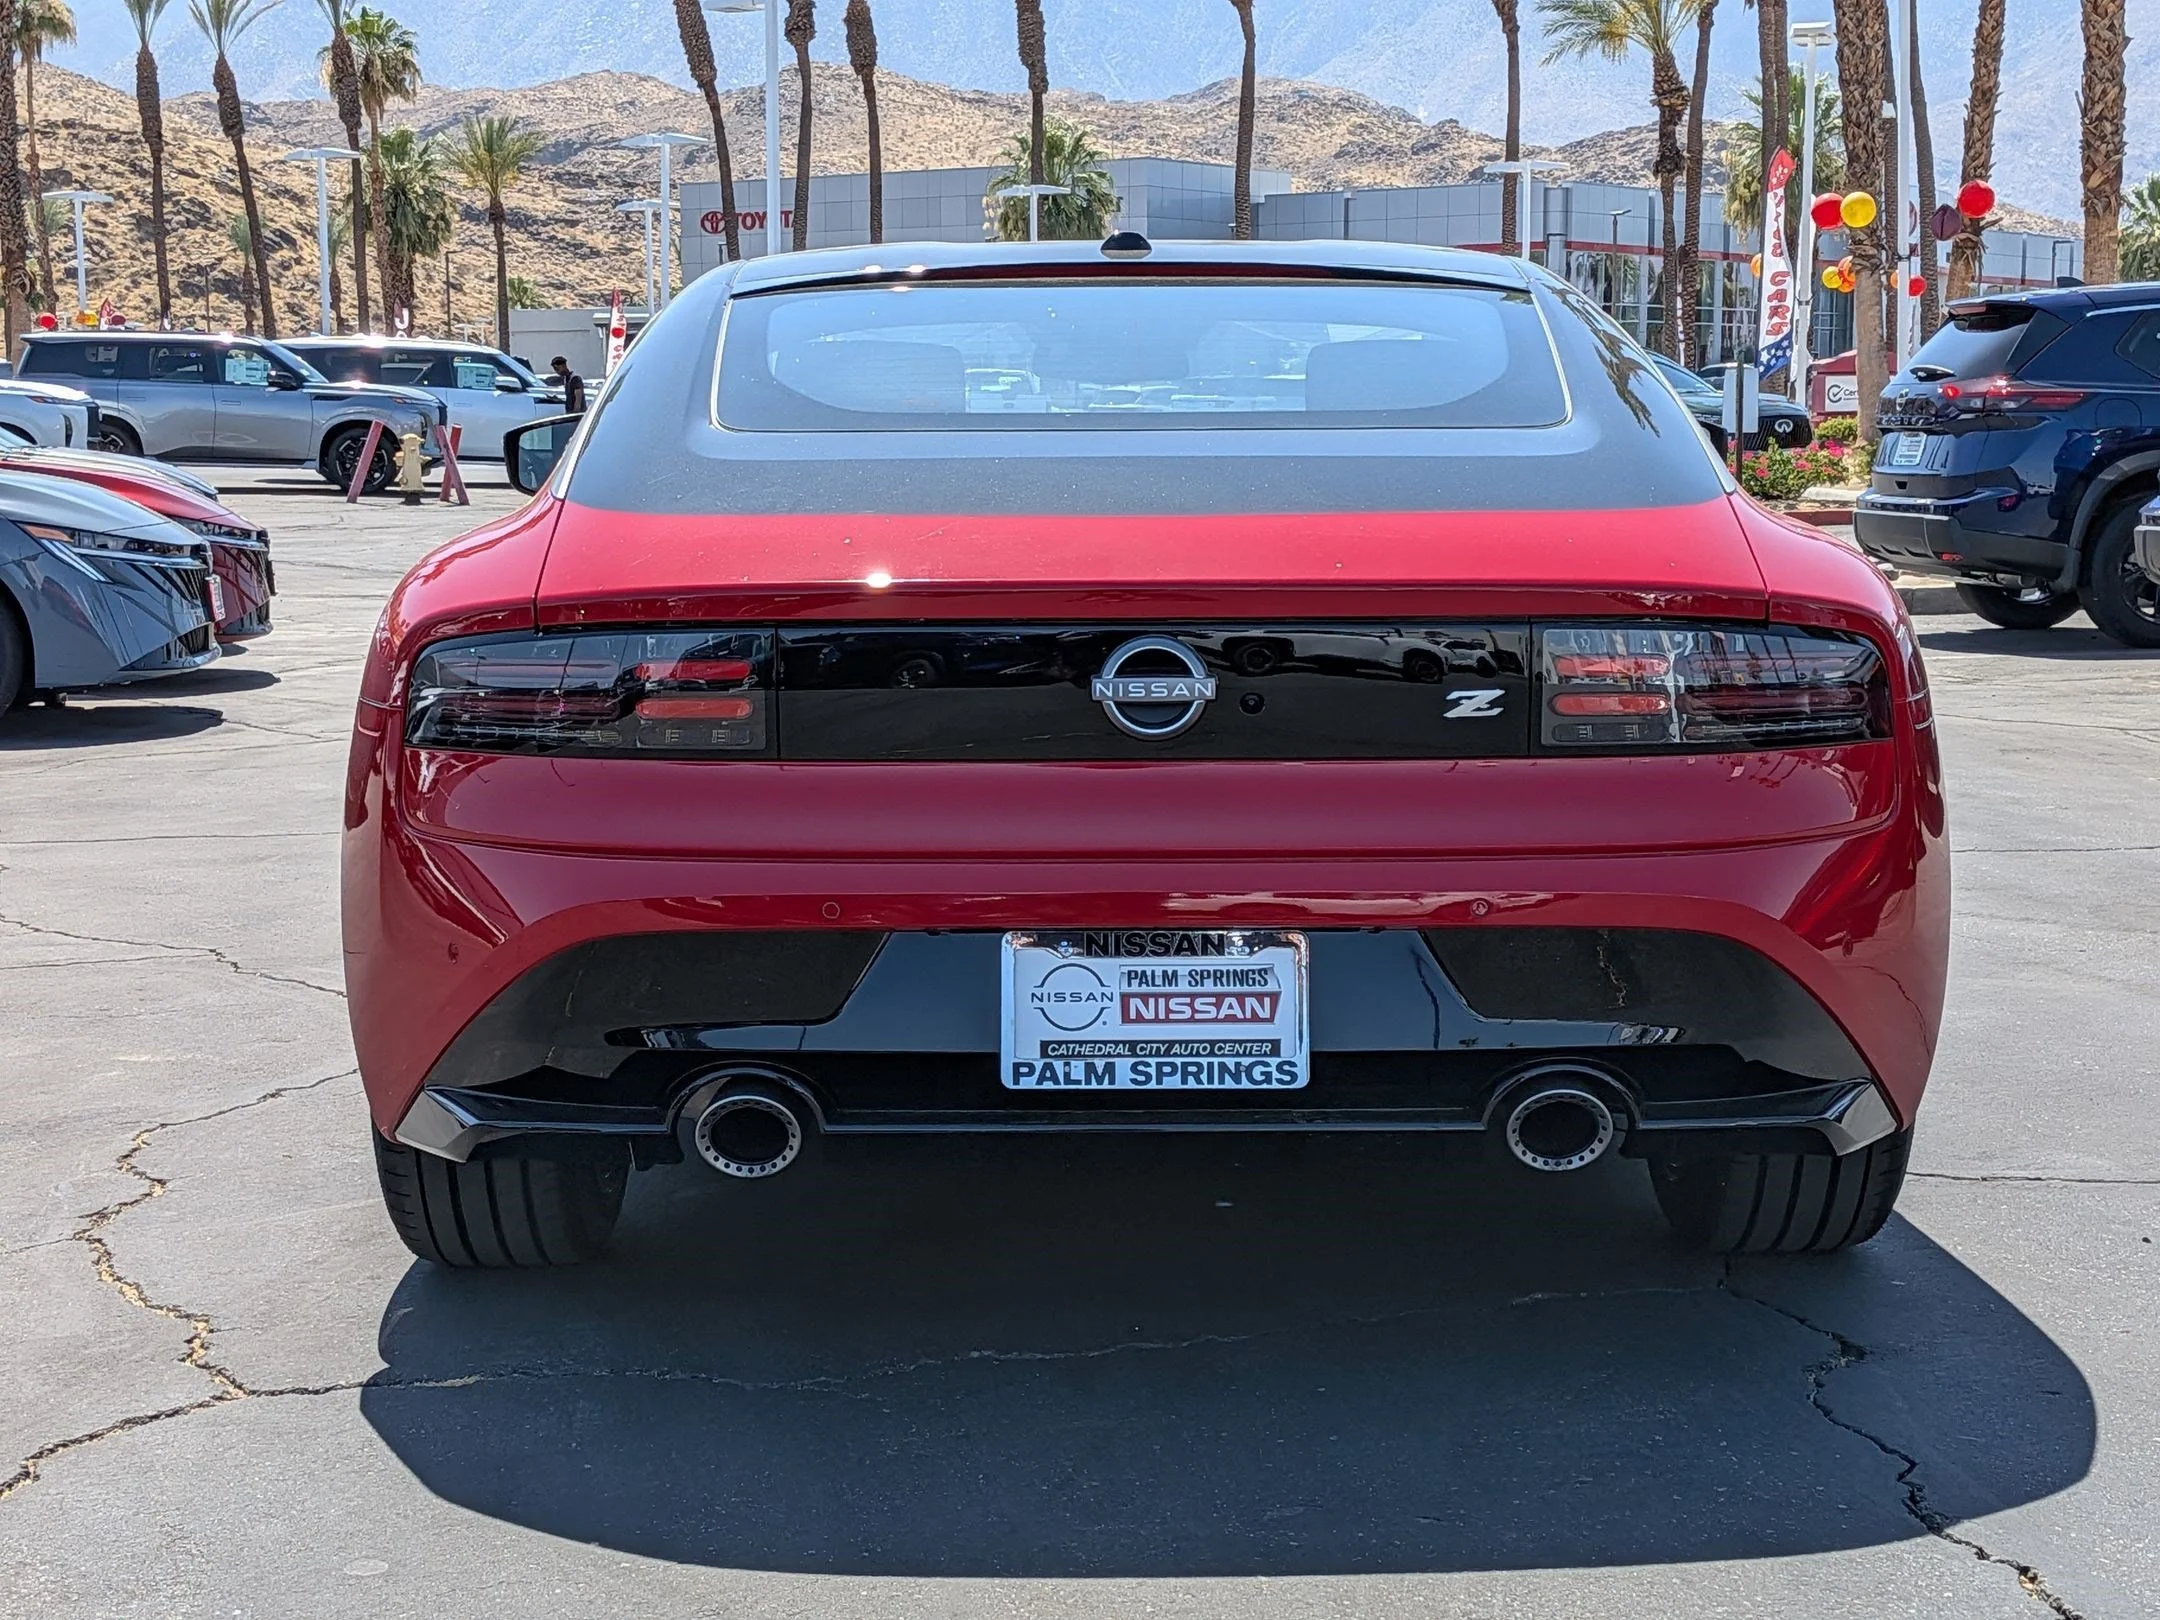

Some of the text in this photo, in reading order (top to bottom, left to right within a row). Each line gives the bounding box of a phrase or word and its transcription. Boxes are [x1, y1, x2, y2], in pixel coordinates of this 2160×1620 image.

[736, 210, 796, 231] OYT
[1766, 270, 1791, 336] CARS
[1095, 682, 1213, 698] NISSAN
[1442, 688, 1506, 718] Z
[1084, 931, 1226, 957] NISSAN
[1126, 968, 1270, 989] PALM SPRINGS
[1031, 991, 1115, 1004] NISSAN
[1128, 996, 1272, 1020] NISSAN
[1047, 1042, 1272, 1056] CATHEDRAL CITY AUTO CENTER
[1011, 1060, 1300, 1086] PALM SPRINGS
